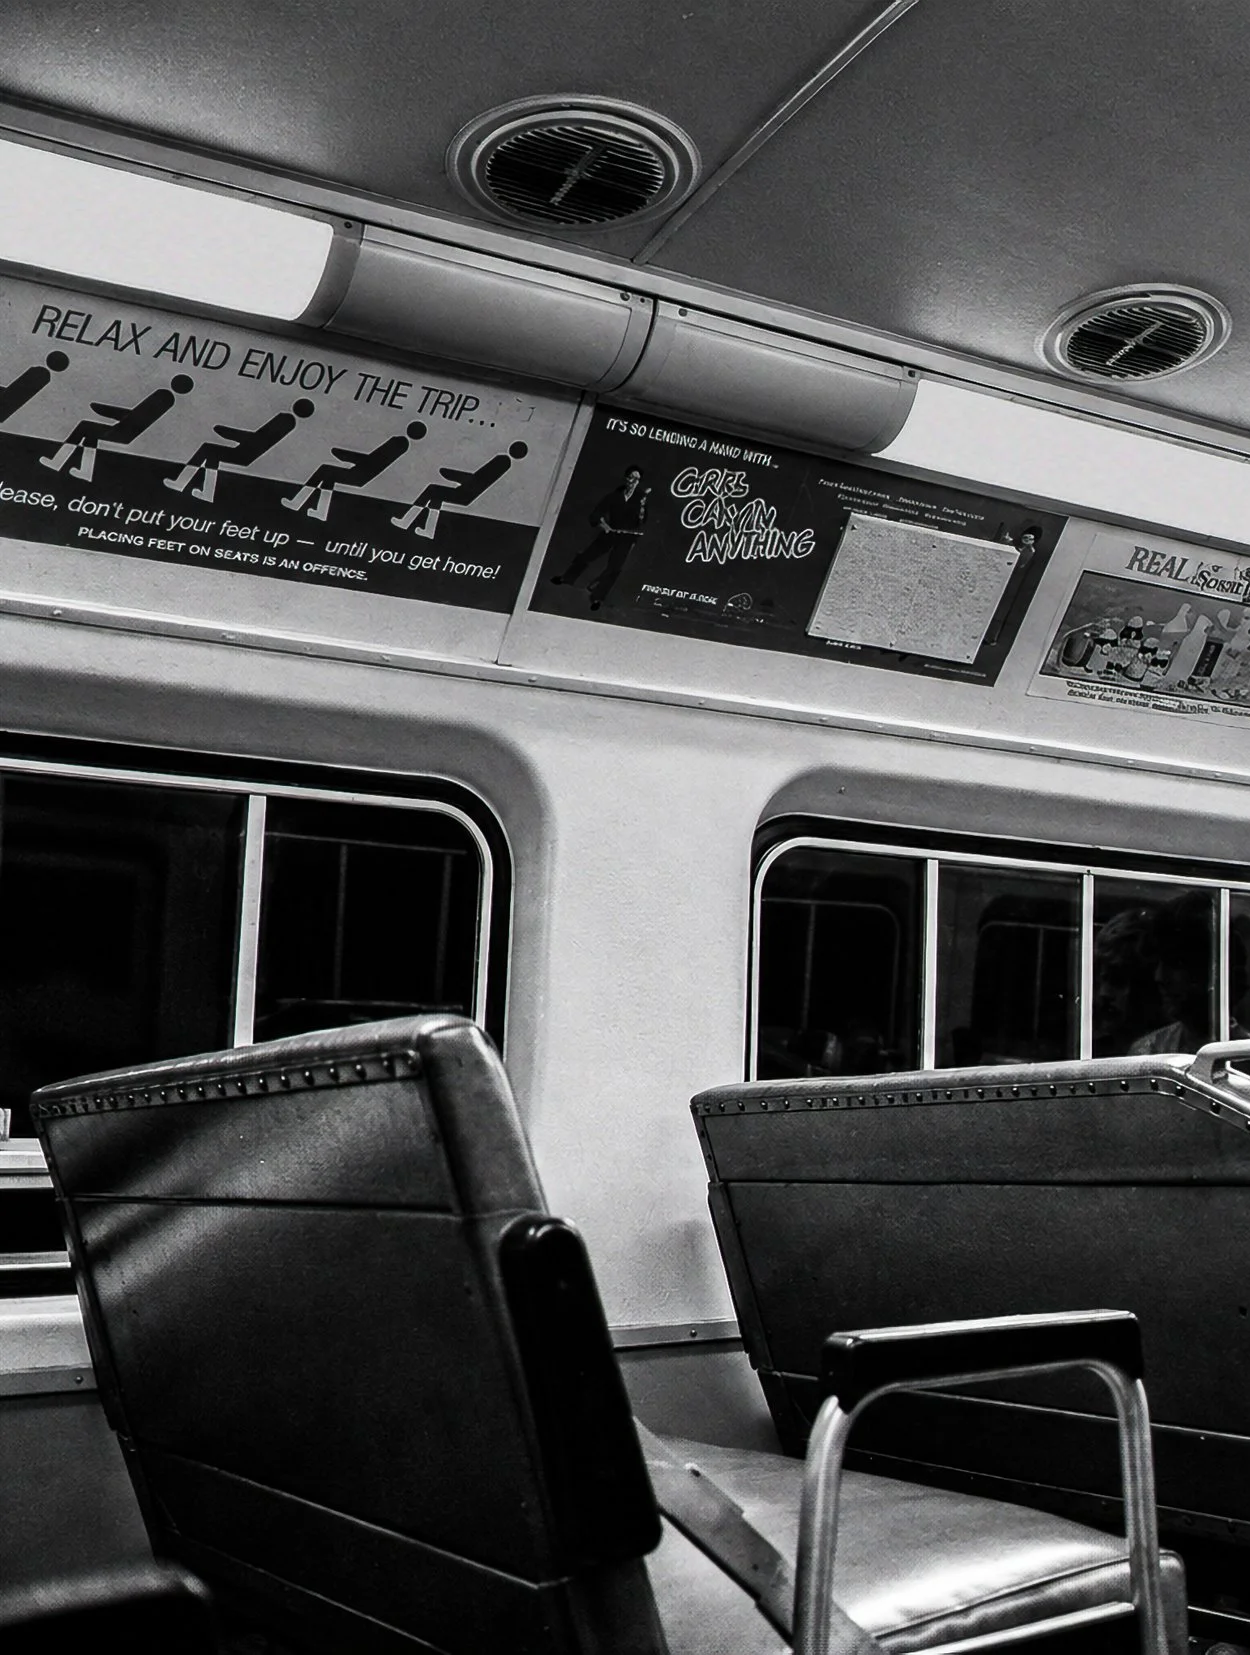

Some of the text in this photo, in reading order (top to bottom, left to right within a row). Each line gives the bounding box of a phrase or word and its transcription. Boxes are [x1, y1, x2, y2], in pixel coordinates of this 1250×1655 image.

[32, 304, 496, 428] RELAX AND ENJOY THE TRIP...
[649, 427, 698, 449] LENDING
[698, 440, 707, 451] A
[67, 496, 124, 519] don't
[125, 508, 165, 525] put
[166, 515, 216, 533] your
[219, 520, 260, 541] feet
[263, 530, 290, 548] up
[325, 540, 369, 558] until
[368, 548, 405, 565] you
[408, 554, 441, 571] get
[442, 557, 502, 580] home!
[78, 526, 164, 546] PLACING
[148, 538, 186, 553] FEET
[189, 544, 211, 557] ON
[214, 548, 260, 564] SEATS
[262, 555, 276, 566] IS
[280, 559, 299, 570] AN
[685, 529, 816, 565] ANYTHING
[1125, 546, 1190, 582] REAL
